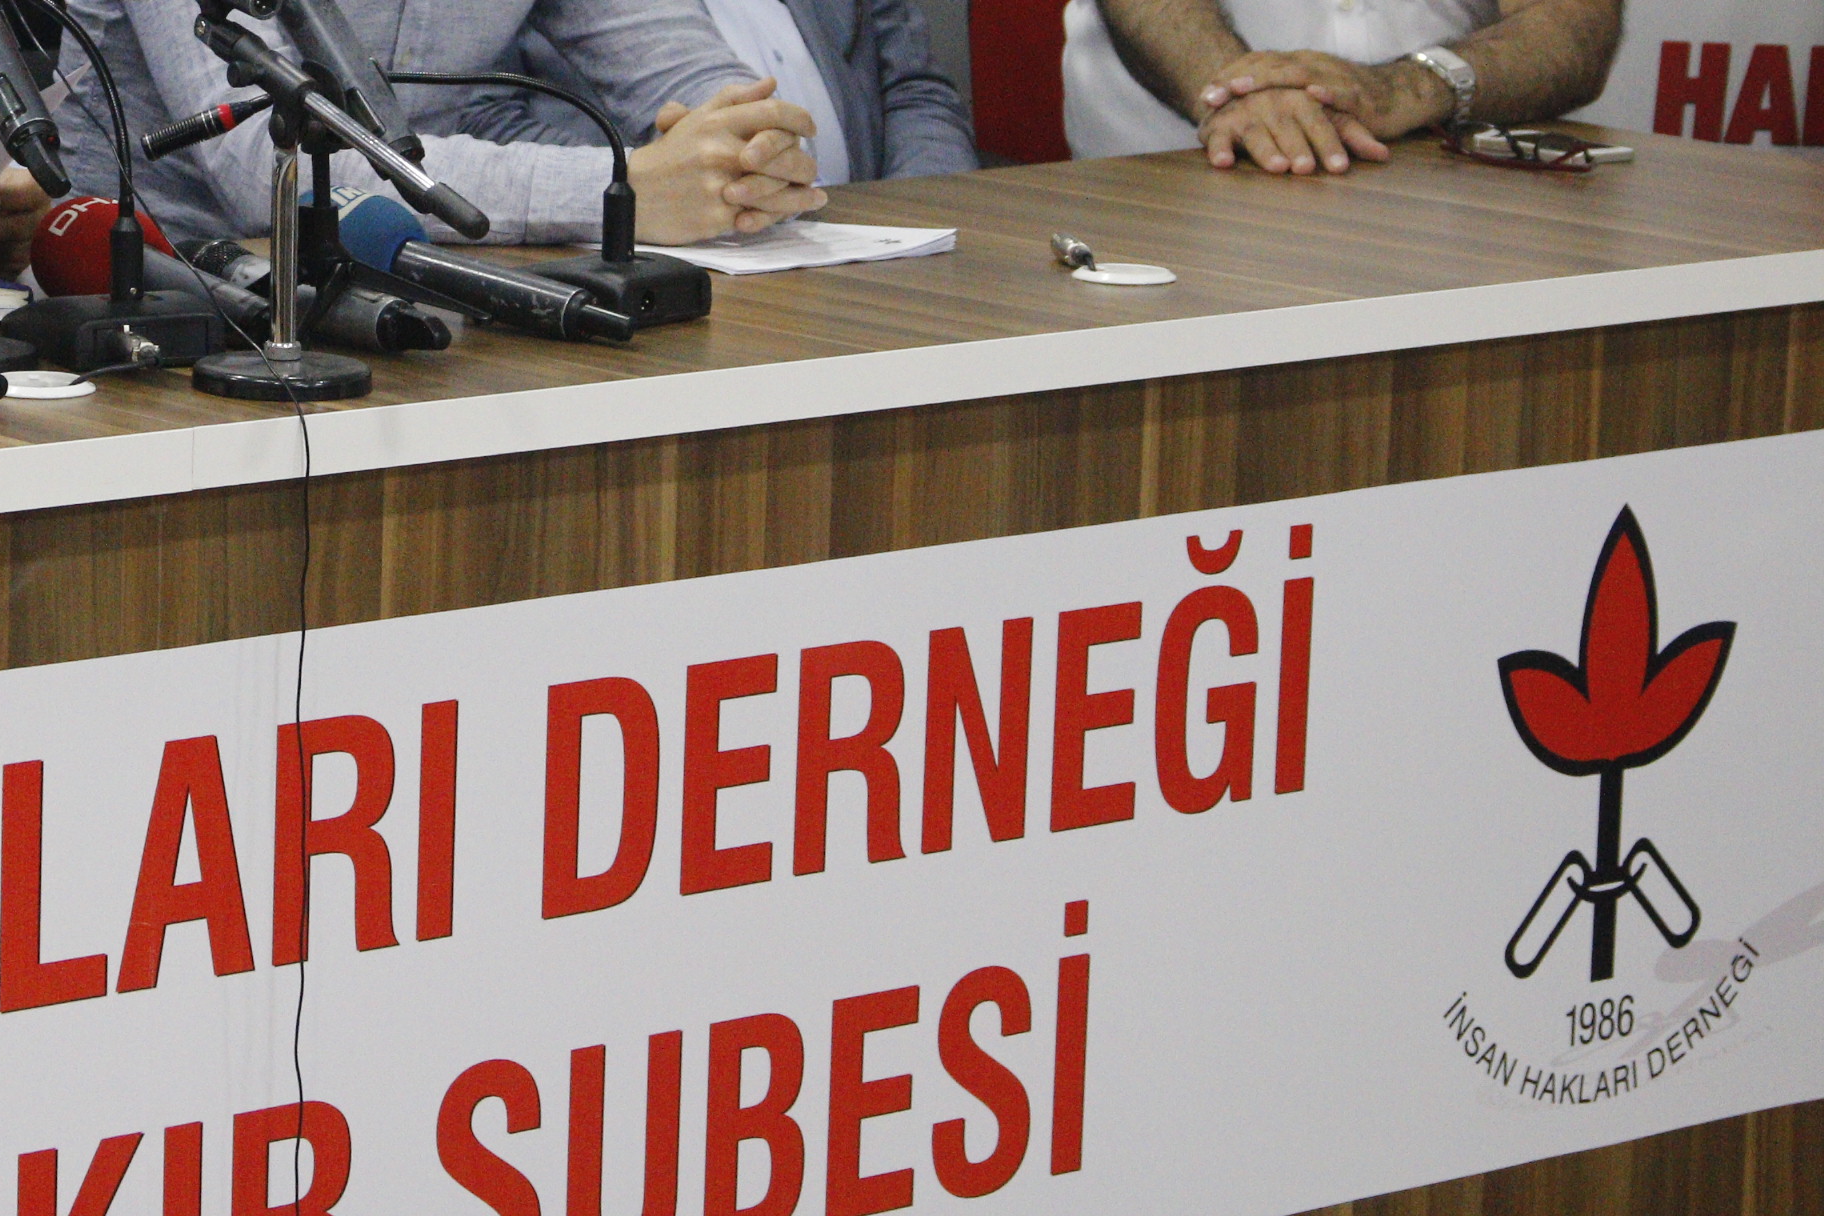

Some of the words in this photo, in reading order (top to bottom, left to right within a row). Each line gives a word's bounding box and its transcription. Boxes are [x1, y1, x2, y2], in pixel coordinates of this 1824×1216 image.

[48, 197, 119, 237] DH
[542, 523, 1314, 920] DERNEĞİ
[1443, 991, 1519, 1086] İNSAN
[1519, 1060, 1638, 1104] HAKLARI
[1647, 936, 1761, 1080] DERNEĞİ
[1565, 995, 1635, 1046] 1986
